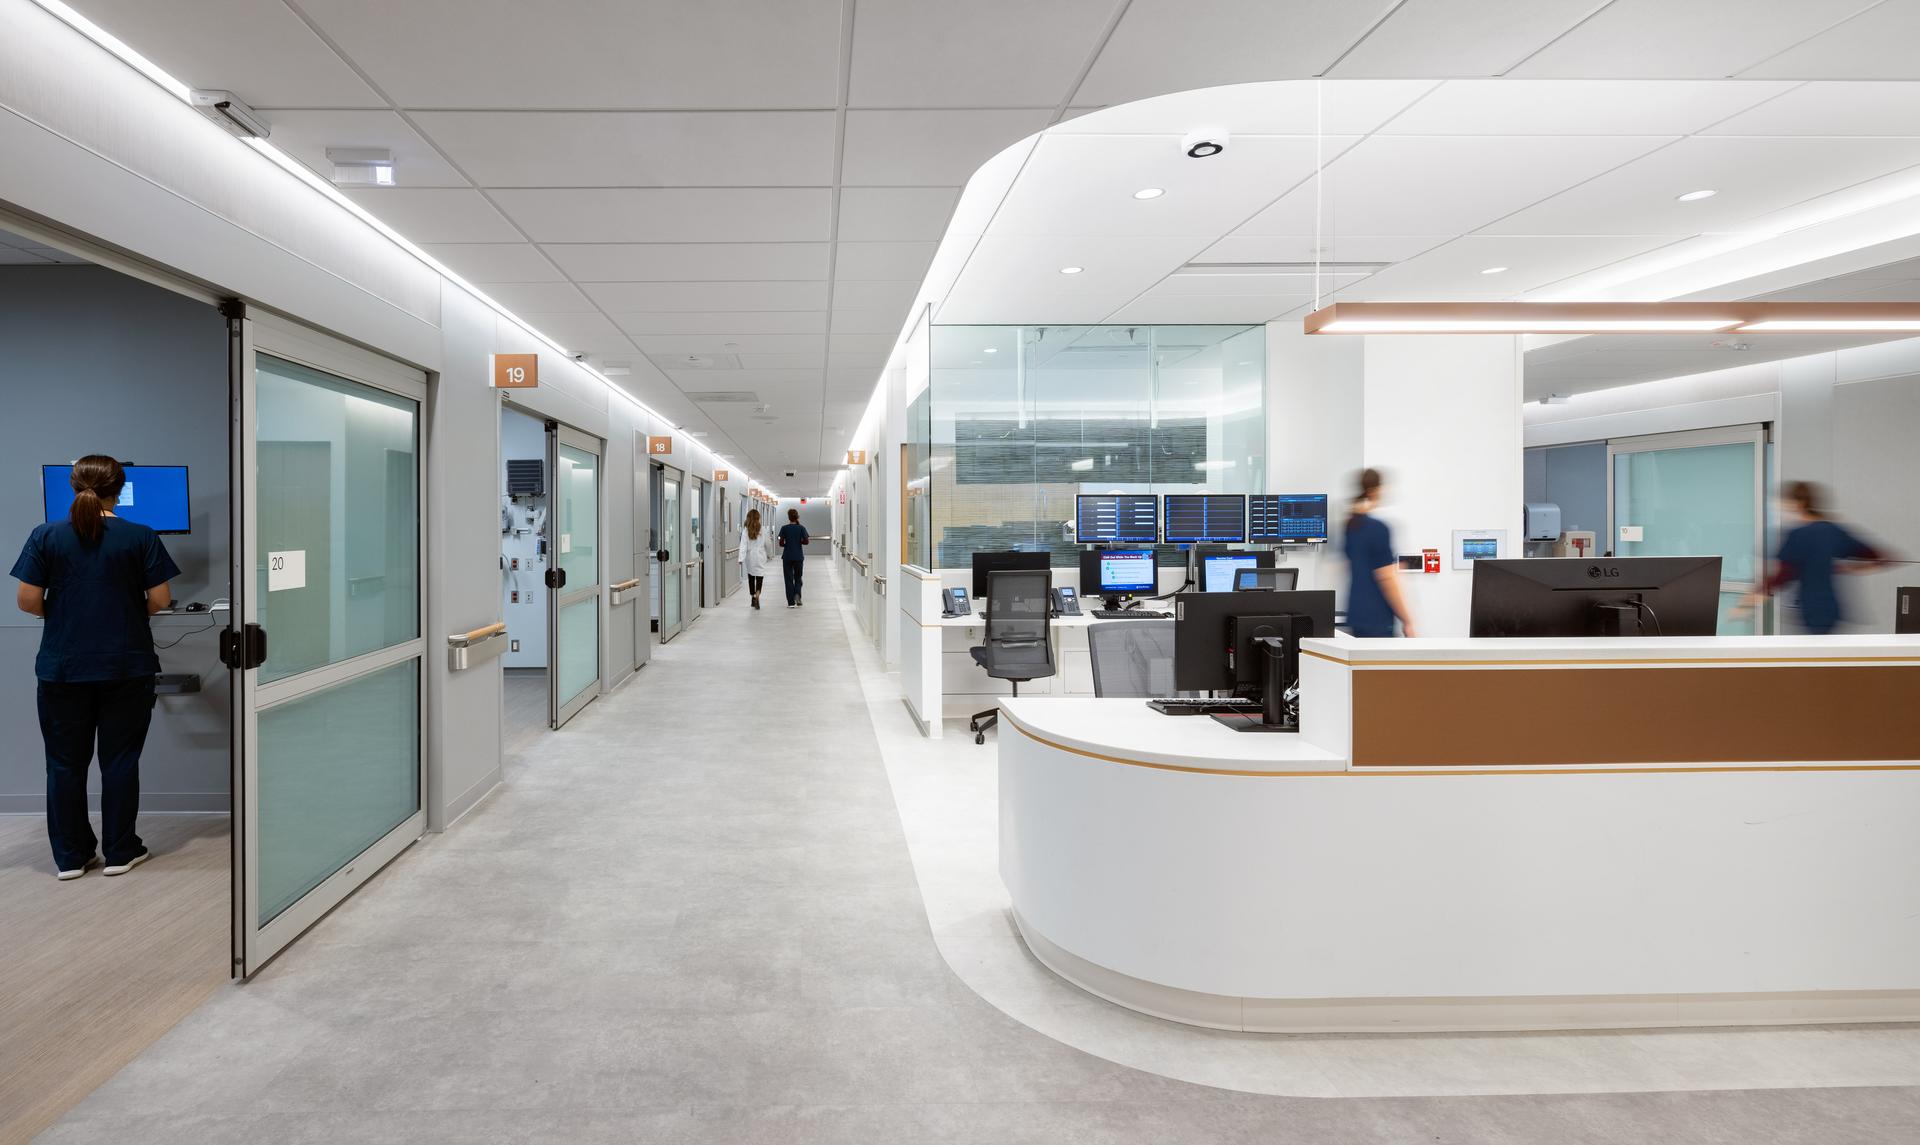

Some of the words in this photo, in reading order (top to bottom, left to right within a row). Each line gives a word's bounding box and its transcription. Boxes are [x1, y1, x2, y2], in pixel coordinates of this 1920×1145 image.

[506, 367, 525, 383] 19
[656, 443, 665, 452] 18
[272, 556, 284, 570] 20
[1603, 567, 1620, 577] LG
